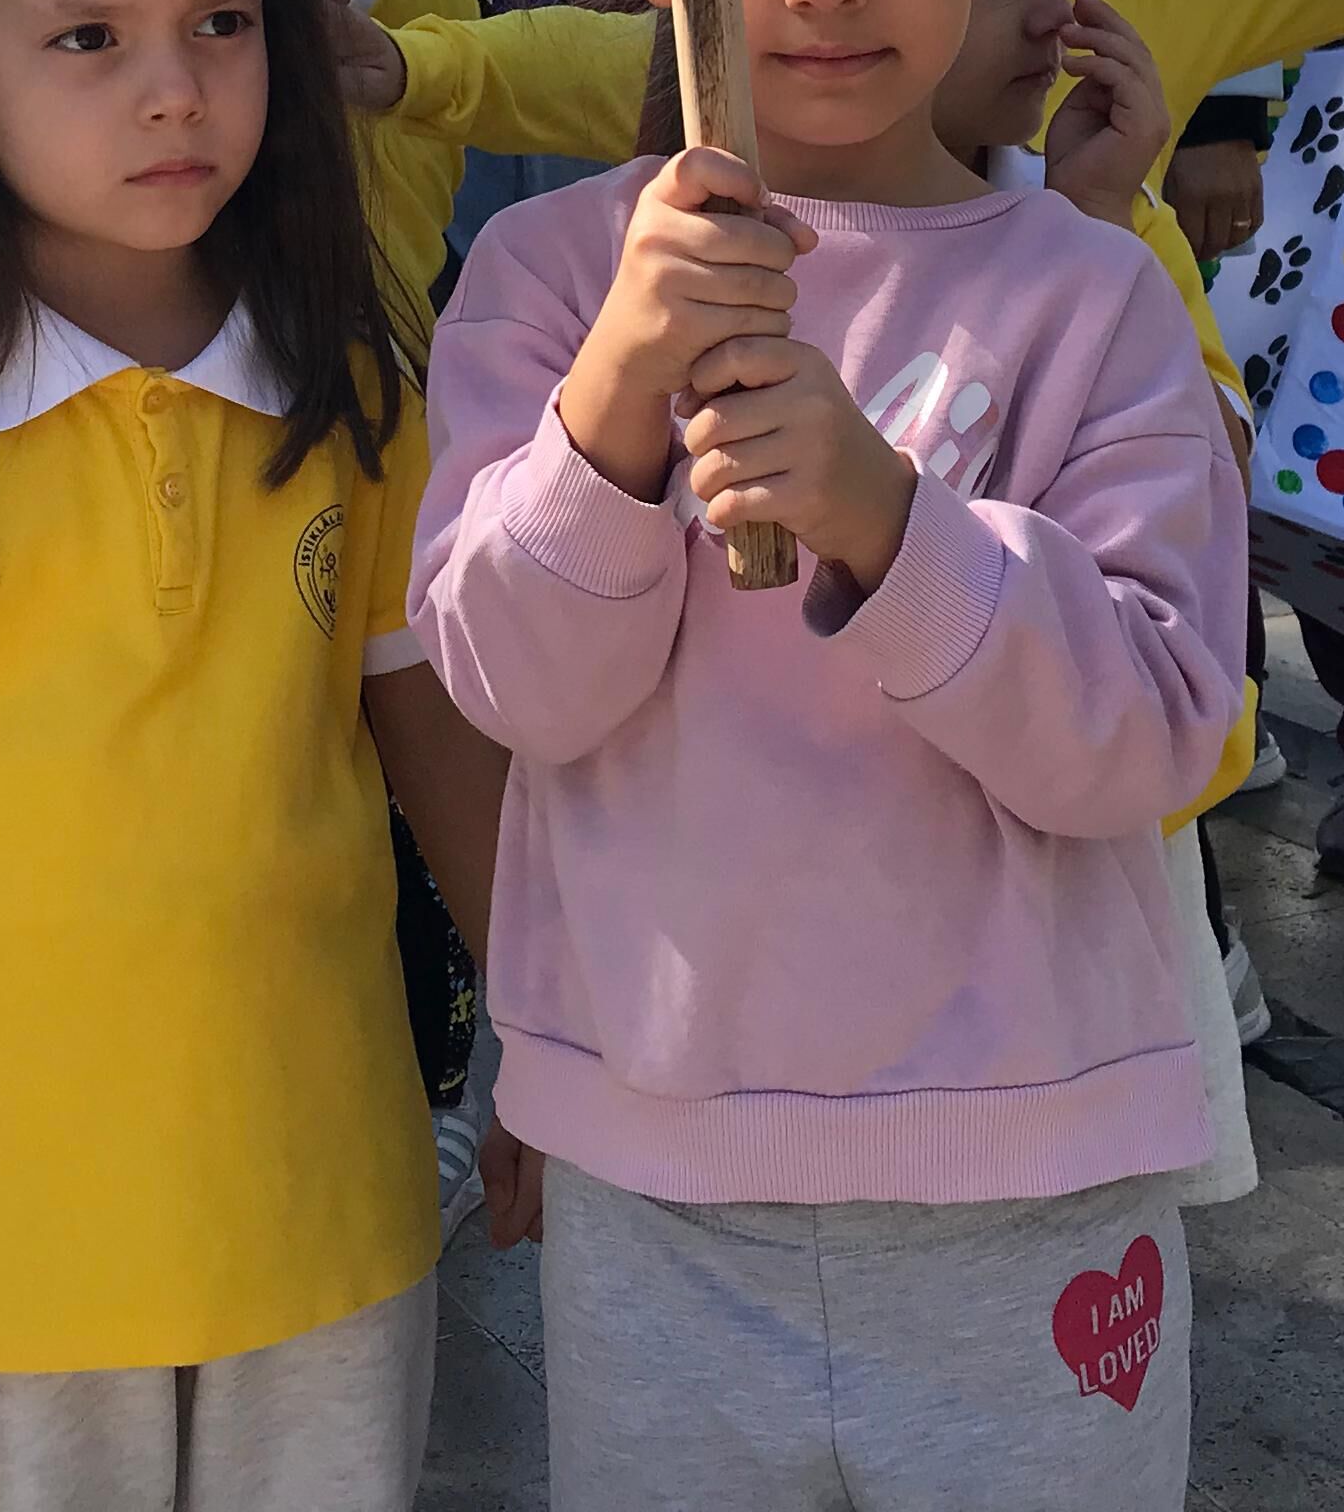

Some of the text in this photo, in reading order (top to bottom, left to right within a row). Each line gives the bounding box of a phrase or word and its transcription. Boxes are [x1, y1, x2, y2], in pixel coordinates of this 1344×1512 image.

[1090, 1276, 1145, 1335] I AM
[1079, 1317, 1159, 1394] LOVED
